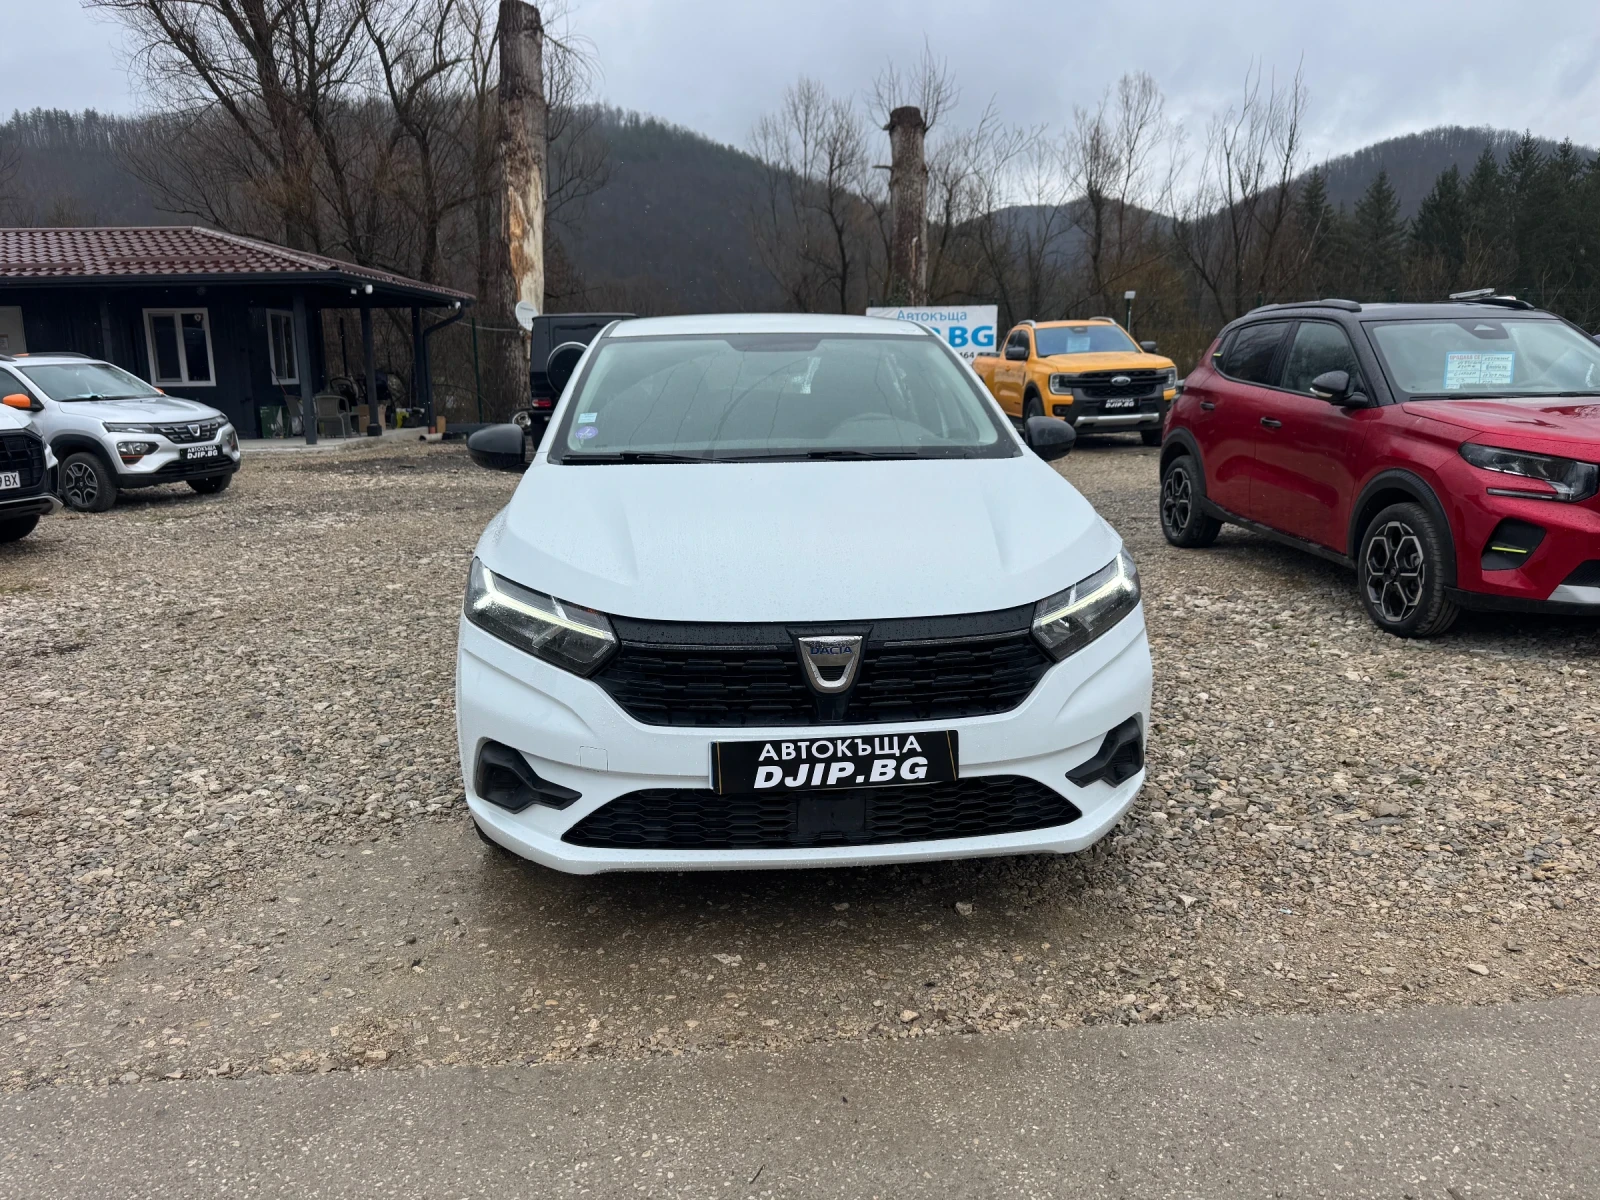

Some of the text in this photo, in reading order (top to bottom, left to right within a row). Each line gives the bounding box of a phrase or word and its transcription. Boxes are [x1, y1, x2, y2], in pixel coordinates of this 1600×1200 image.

[897, 310, 967, 322] Автокъща
[187, 450, 218, 459] DJIP.BG
[810, 646, 852, 655] DACIA
[758, 735, 922, 761] АВТОКЪЩА
[754, 756, 929, 789] DJIP.BG
